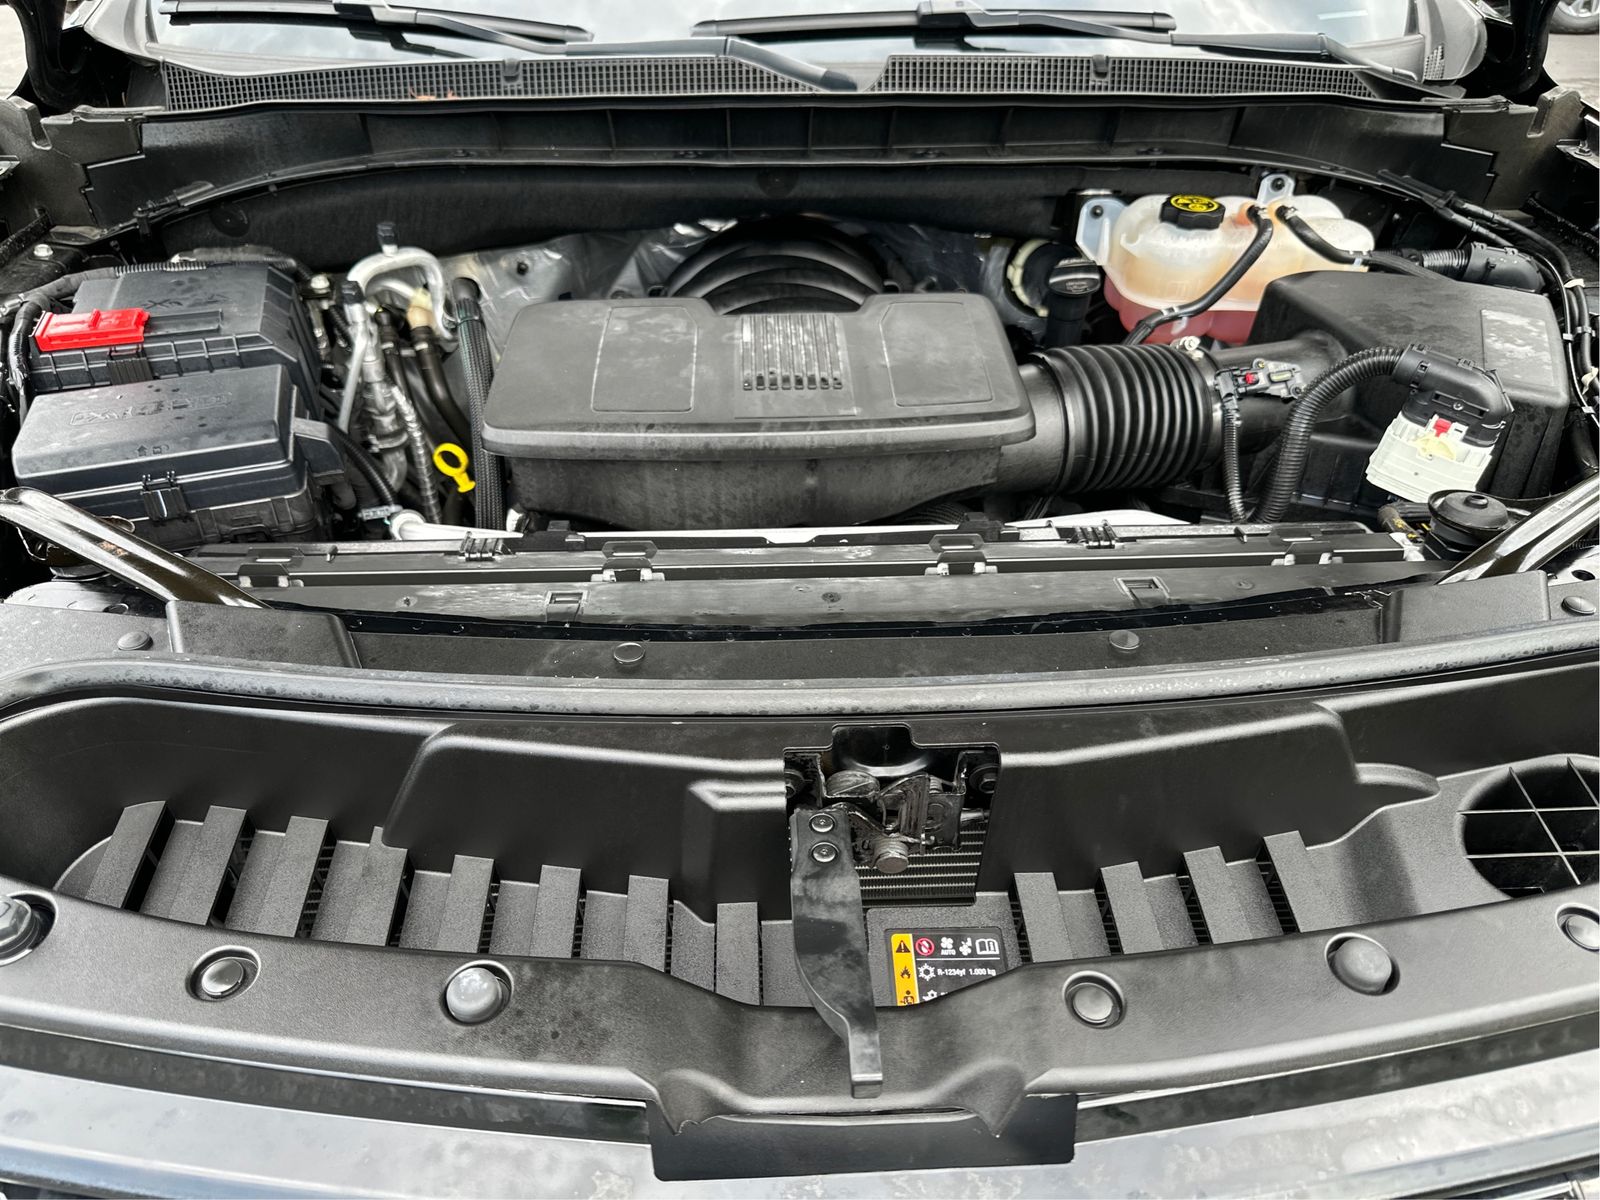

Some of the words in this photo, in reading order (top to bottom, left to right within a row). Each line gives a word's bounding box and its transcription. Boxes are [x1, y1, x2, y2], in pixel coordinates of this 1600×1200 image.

[937, 968, 966, 977] R-1234yf
[969, 968, 986, 976] 1.000
[987, 968, 997, 977] kg
